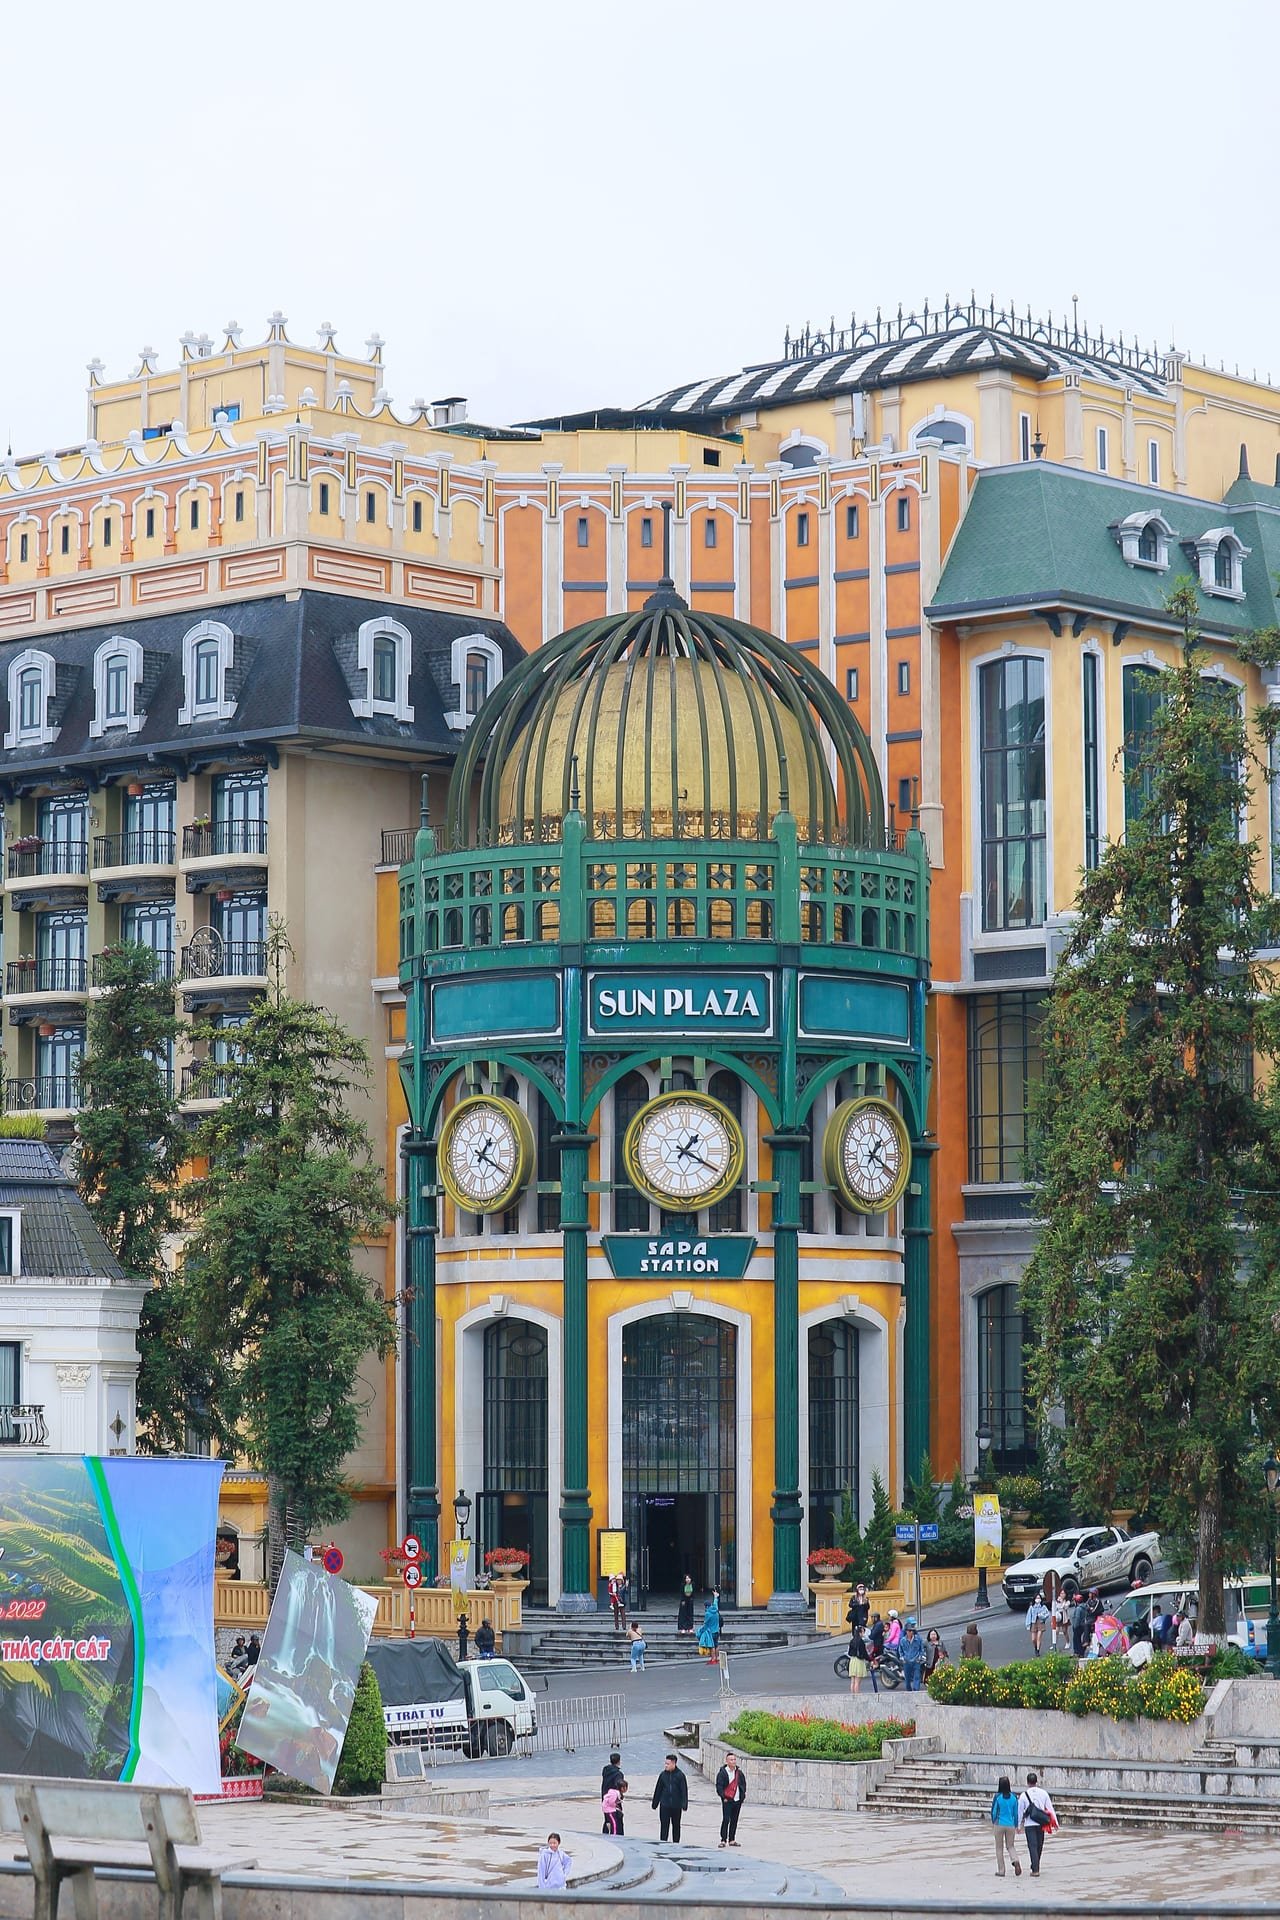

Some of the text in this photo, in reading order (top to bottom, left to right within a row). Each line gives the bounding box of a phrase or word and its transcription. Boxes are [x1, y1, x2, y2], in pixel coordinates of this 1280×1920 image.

[599, 989, 760, 1016] SUN PLAZA
[648, 1241, 707, 1256] SAPA
[640, 1259, 719, 1273] STATION
[5, 1601, 47, 1618] 2022
[2, 1635, 111, 1661] THÁC CÁT CÁT
